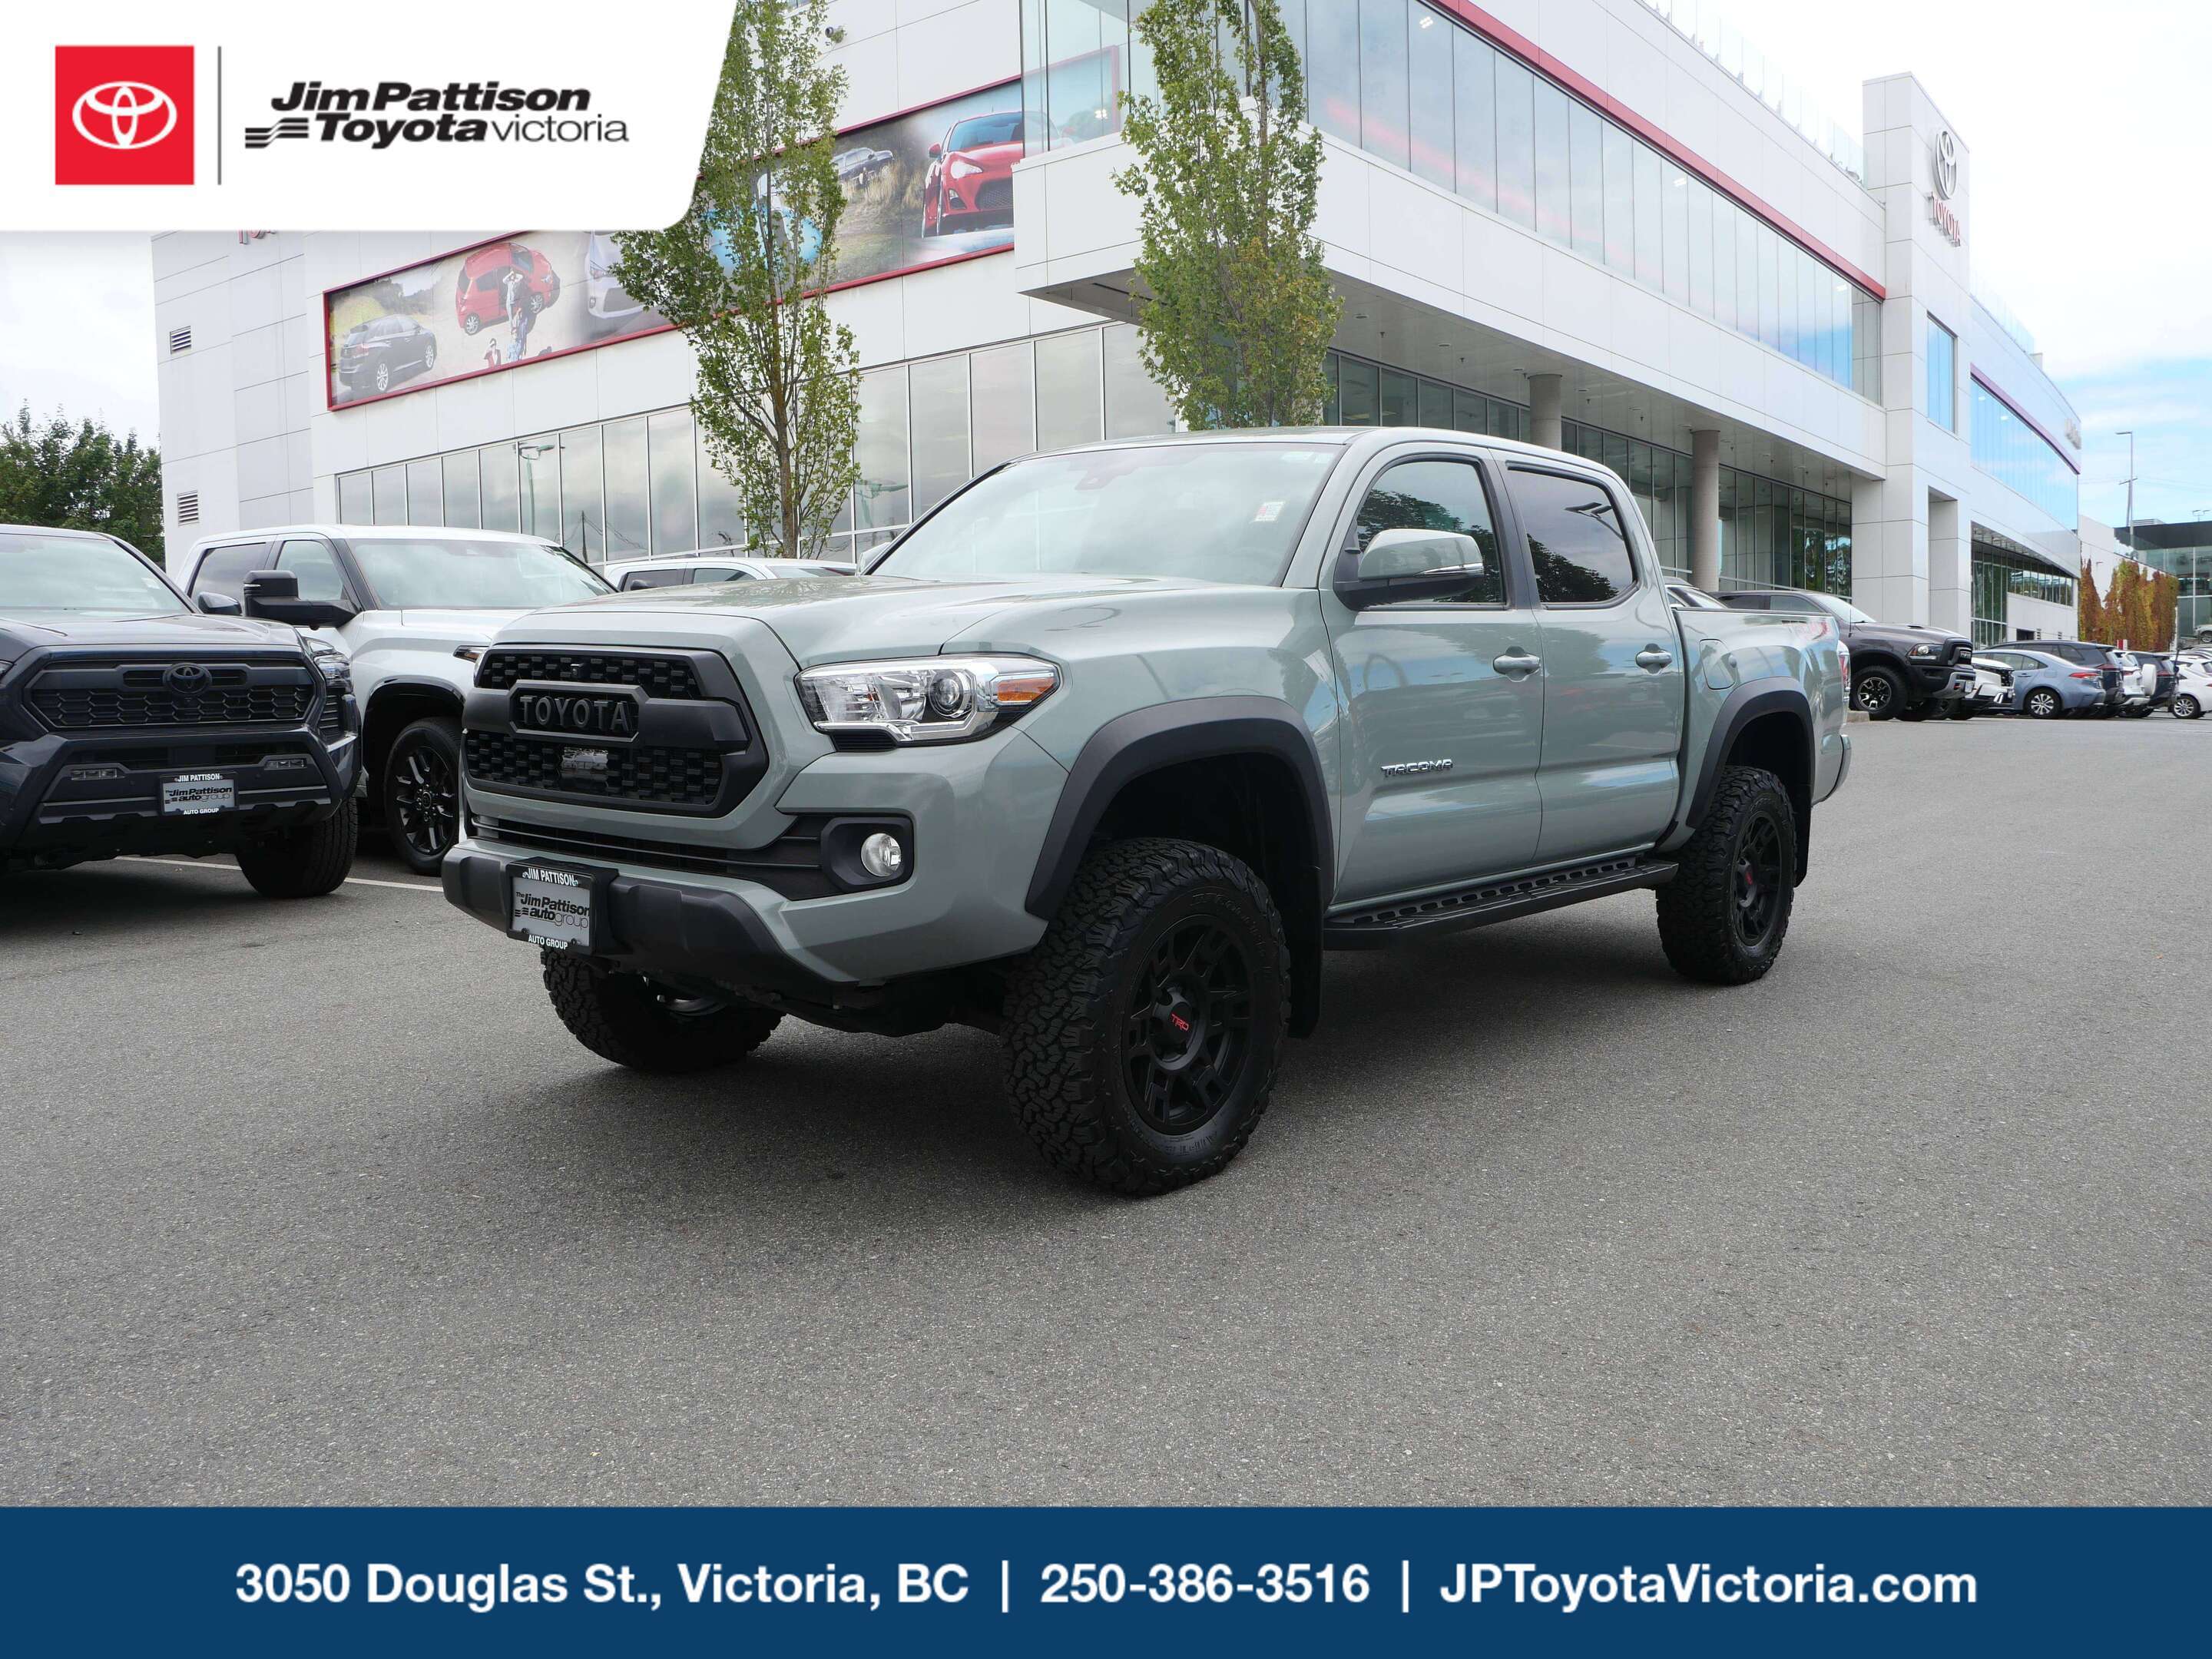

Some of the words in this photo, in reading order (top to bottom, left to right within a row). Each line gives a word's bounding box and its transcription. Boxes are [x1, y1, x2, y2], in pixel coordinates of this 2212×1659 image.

[518, 695, 632, 732] TOYOTA
[1381, 759, 1454, 777] TACOMA
[527, 867, 539, 881] JIM
[541, 869, 575, 886] PATTISON
[528, 934, 545, 945] AUTO
[545, 938, 568, 950] GROUP
[1171, 1013, 1190, 1031] TRD
